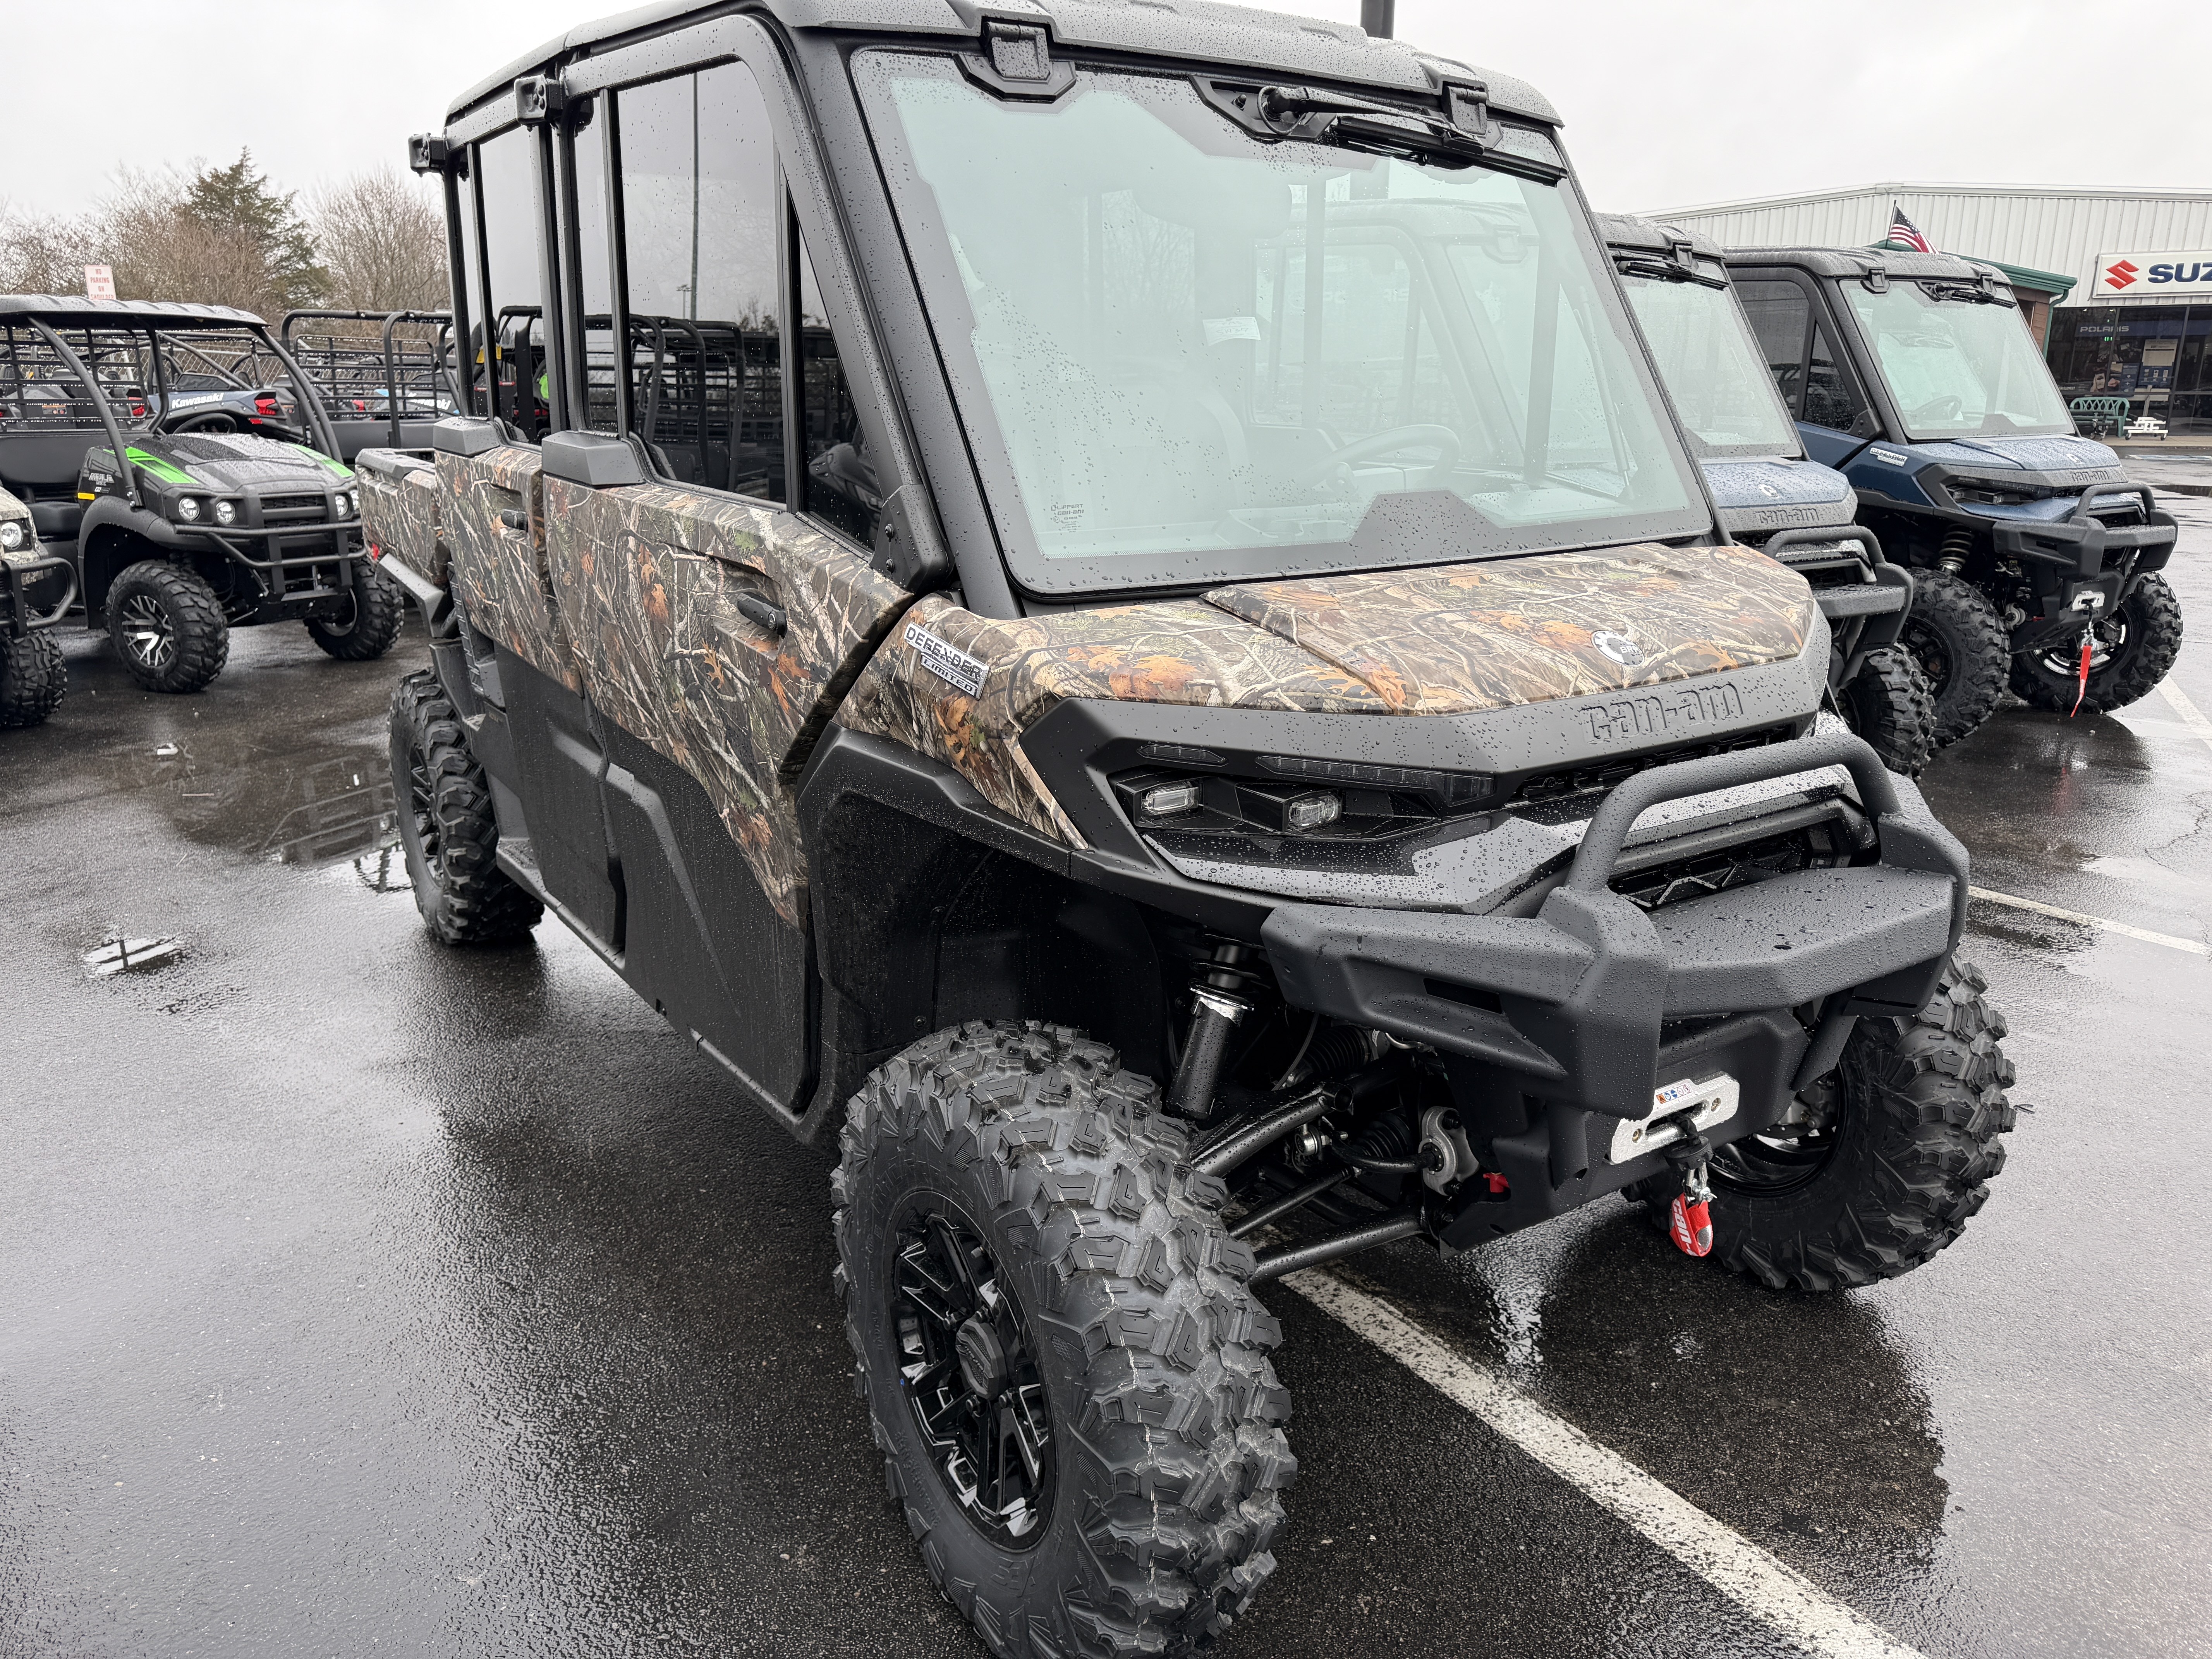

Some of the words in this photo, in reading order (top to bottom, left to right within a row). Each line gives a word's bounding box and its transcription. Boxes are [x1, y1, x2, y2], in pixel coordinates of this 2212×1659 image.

[172, 392, 224, 409] Kawasaki
[906, 626, 984, 680] DEFENDER
[923, 658, 973, 692] LIMITED
